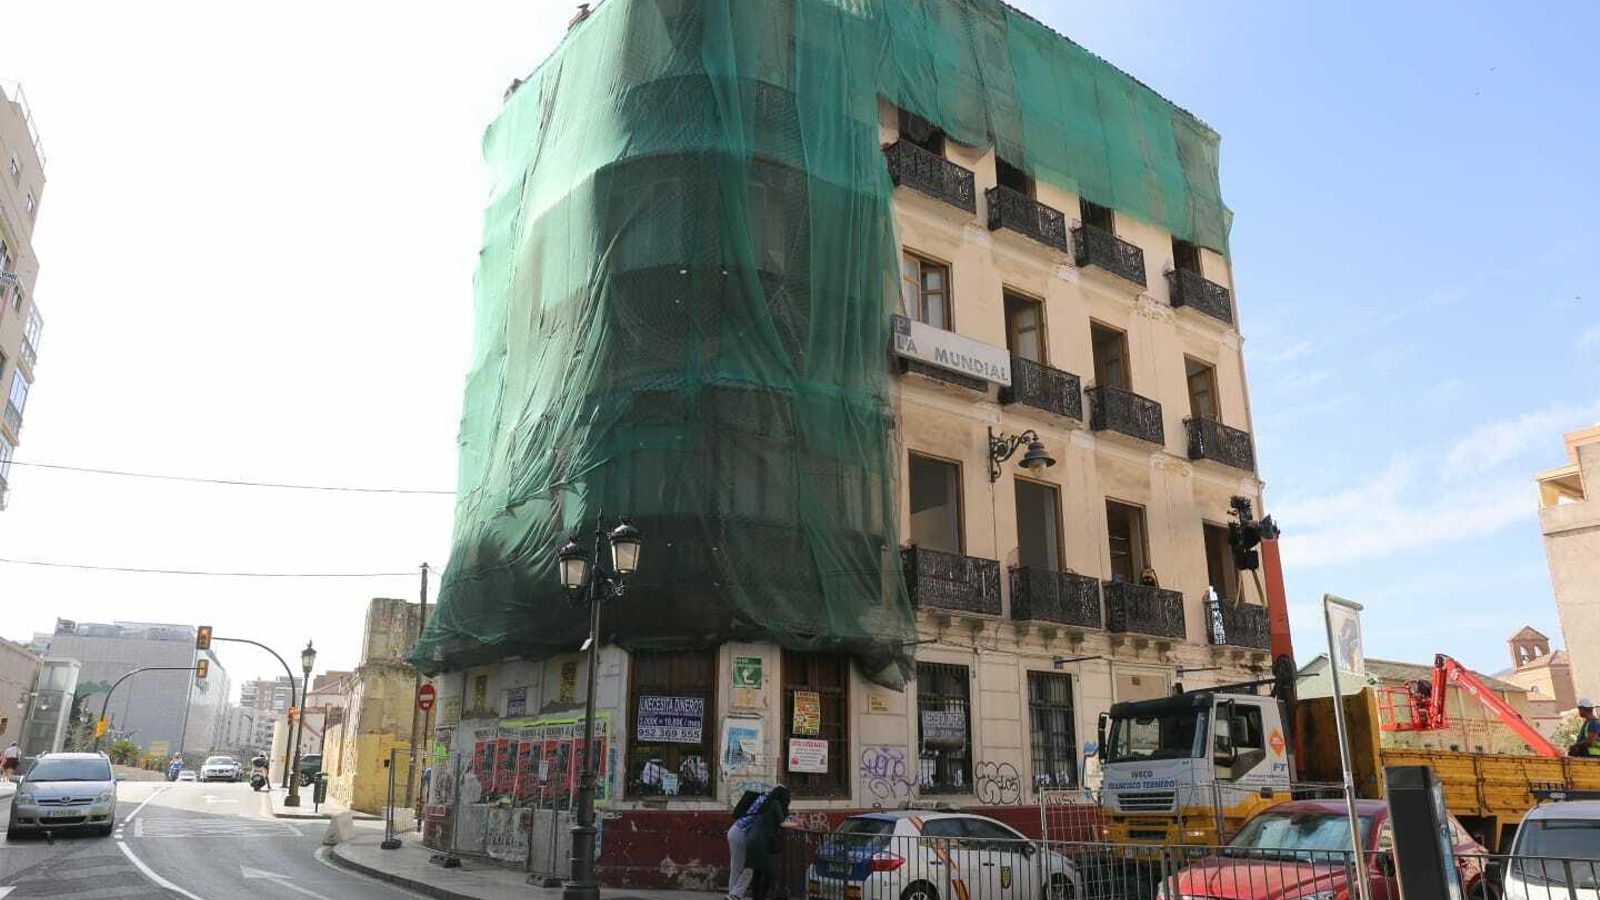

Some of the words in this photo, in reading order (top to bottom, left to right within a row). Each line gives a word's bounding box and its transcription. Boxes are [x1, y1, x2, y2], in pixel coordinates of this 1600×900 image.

[896, 335, 919, 354] LA
[934, 345, 1009, 381] MUNDIAL
[638, 728, 656, 737] 952
[1131, 770, 1154, 779] IVECO
[1108, 780, 1142, 790] FRANCISCO
